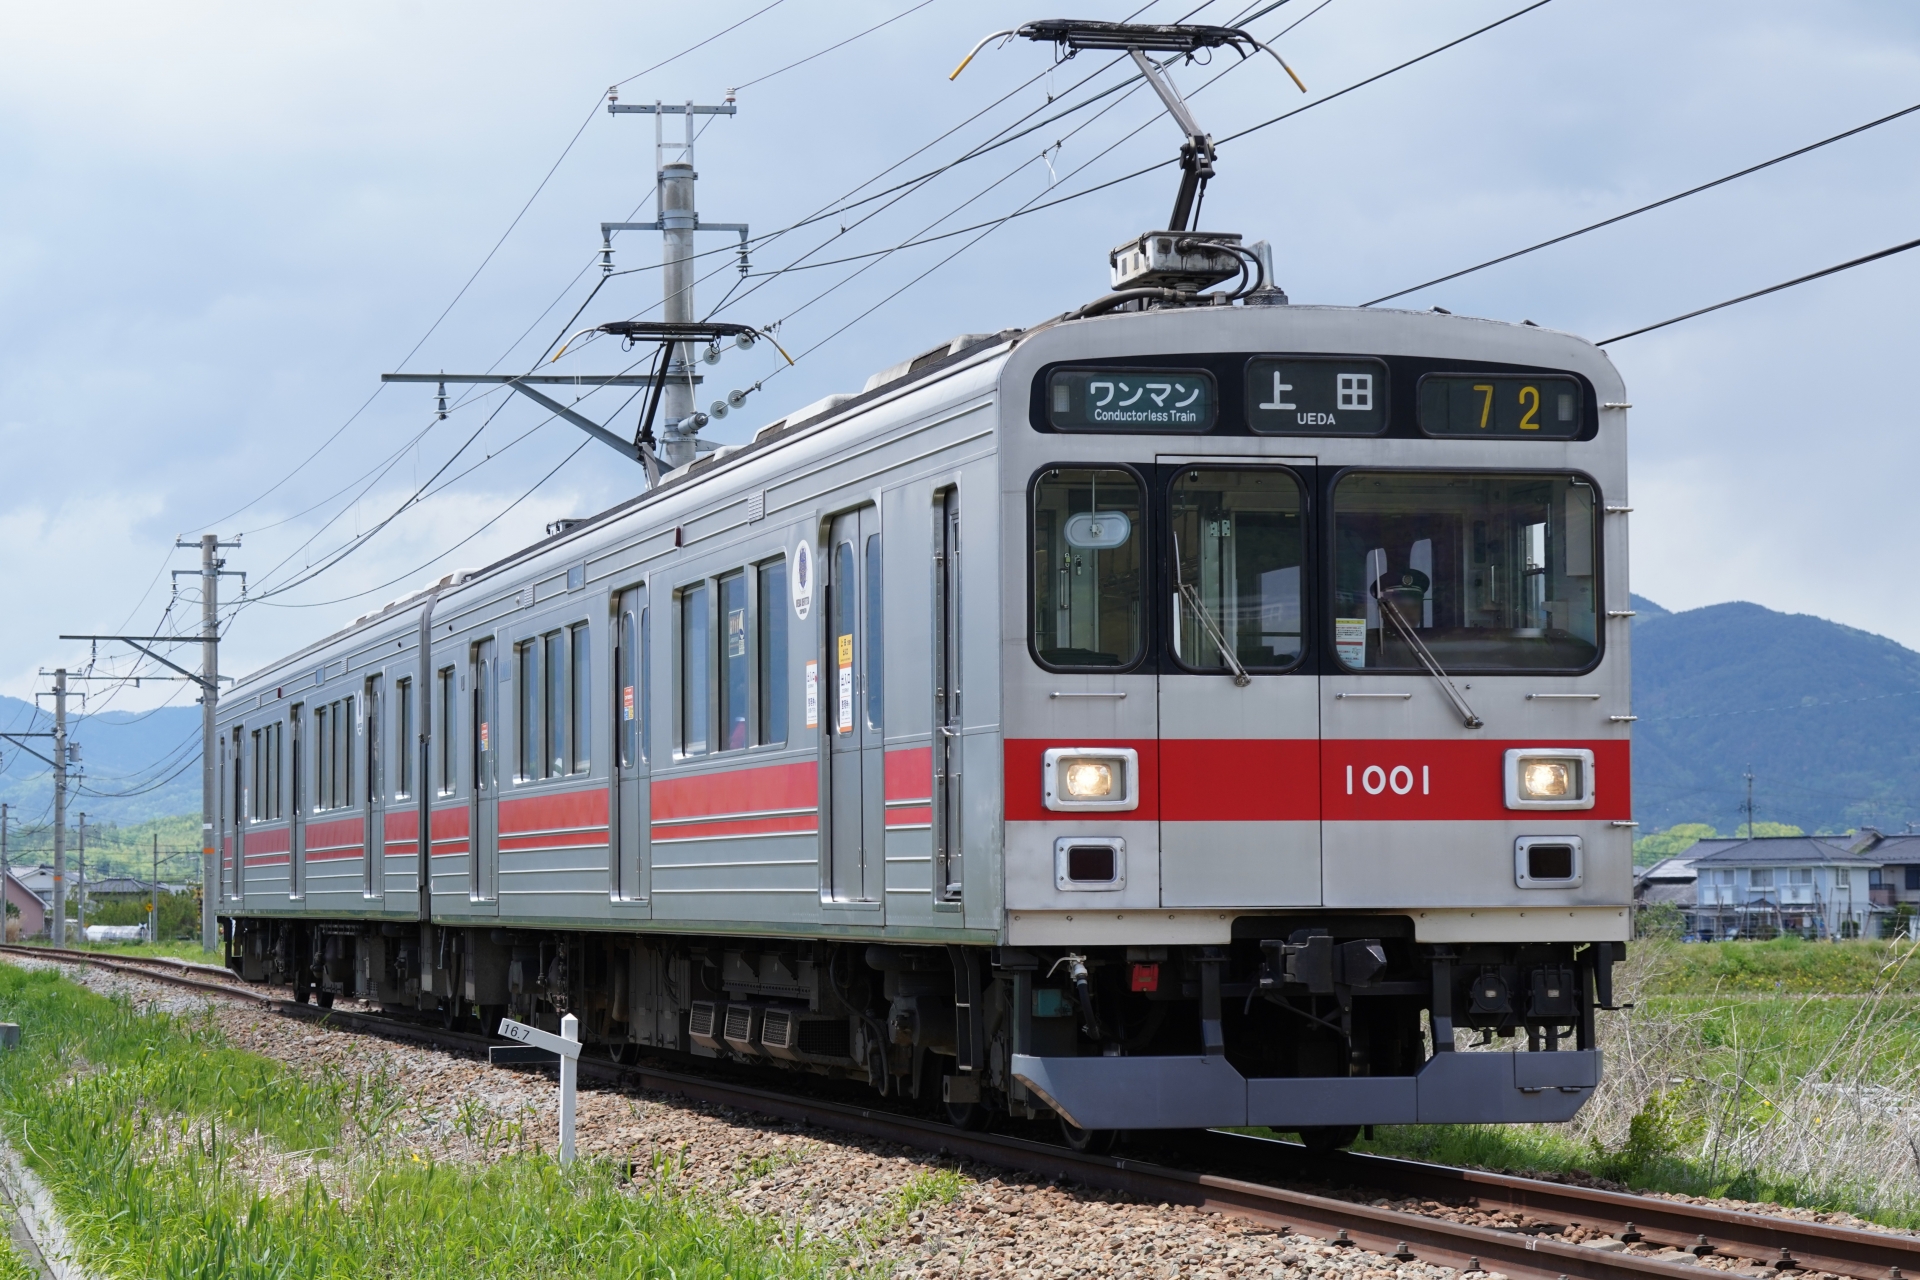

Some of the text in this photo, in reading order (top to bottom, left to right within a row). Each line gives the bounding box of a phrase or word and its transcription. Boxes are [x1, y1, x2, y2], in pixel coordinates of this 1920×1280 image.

[1090, 382, 1199, 407] ワンマン
[1259, 371, 1373, 410] 上田
[1094, 409, 1196, 422] Conductorless Train
[1297, 413, 1336, 425] UEDA
[1346, 765, 1430, 795] 1001
[503, 1023, 530, 1040] 16.7
